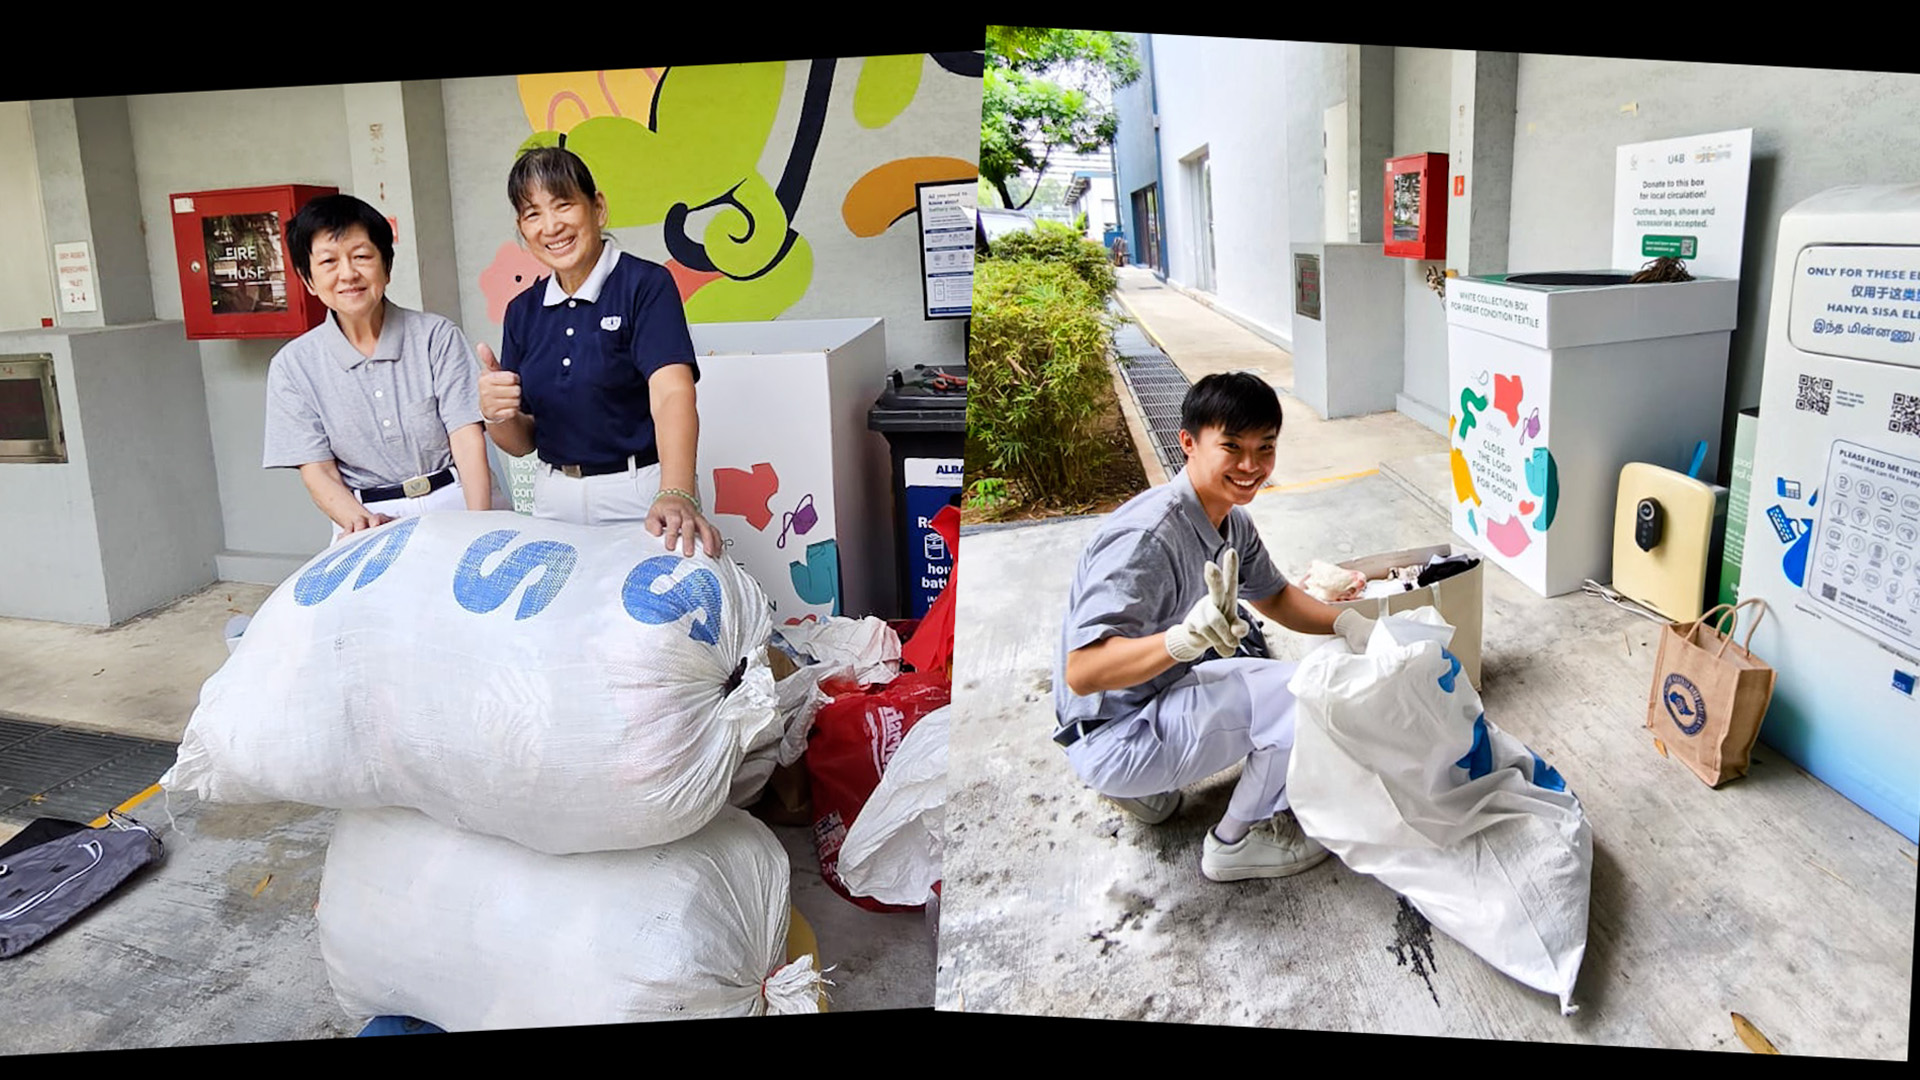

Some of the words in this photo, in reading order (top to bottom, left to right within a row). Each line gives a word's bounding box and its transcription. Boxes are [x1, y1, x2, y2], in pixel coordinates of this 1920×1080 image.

[1643, 180, 1665, 189] Donate
[1667, 180, 1674, 188] to
[1676, 179, 1689, 187] this
[1691, 178, 1704, 187] box
[1640, 192, 1648, 200] for
[1650, 191, 1666, 200] local
[1667, 191, 1707, 199] circulation!
[1679, 207, 1699, 216] shoes
[1701, 207, 1715, 215] and
[225, 245, 257, 260] FIRE
[1807, 267, 1837, 276] ONLY
[1840, 268, 1862, 277] FOR
[1866, 269, 1906, 280] THESE
[1460, 292, 1476, 302] WHITE
[1478, 294, 1514, 308] COLLECTION
[1515, 301, 1529, 311] BOX
[1827, 303, 1868, 315] HANYA
[1872, 307, 1898, 317] SISA
[1451, 301, 1461, 310] FOR
[1462, 304, 1479, 314] GREAT
[1480, 307, 1513, 321] CONDITION
[1514, 314, 1540, 329] TEXTILE
[1483, 440, 1505, 458] CLOSE
[1478, 449, 1490, 464] THE
[1492, 457, 1512, 472] LOOP
[1839, 449, 1865, 463] PLEASE
[1867, 457, 1886, 468] FEED
[1887, 463, 1900, 473] ME
[1472, 460, 1486, 473] FOR
[1487, 468, 1518, 491] FASHION
[1477, 475, 1490, 488] FOR
[1491, 484, 1513, 502] GOOD
